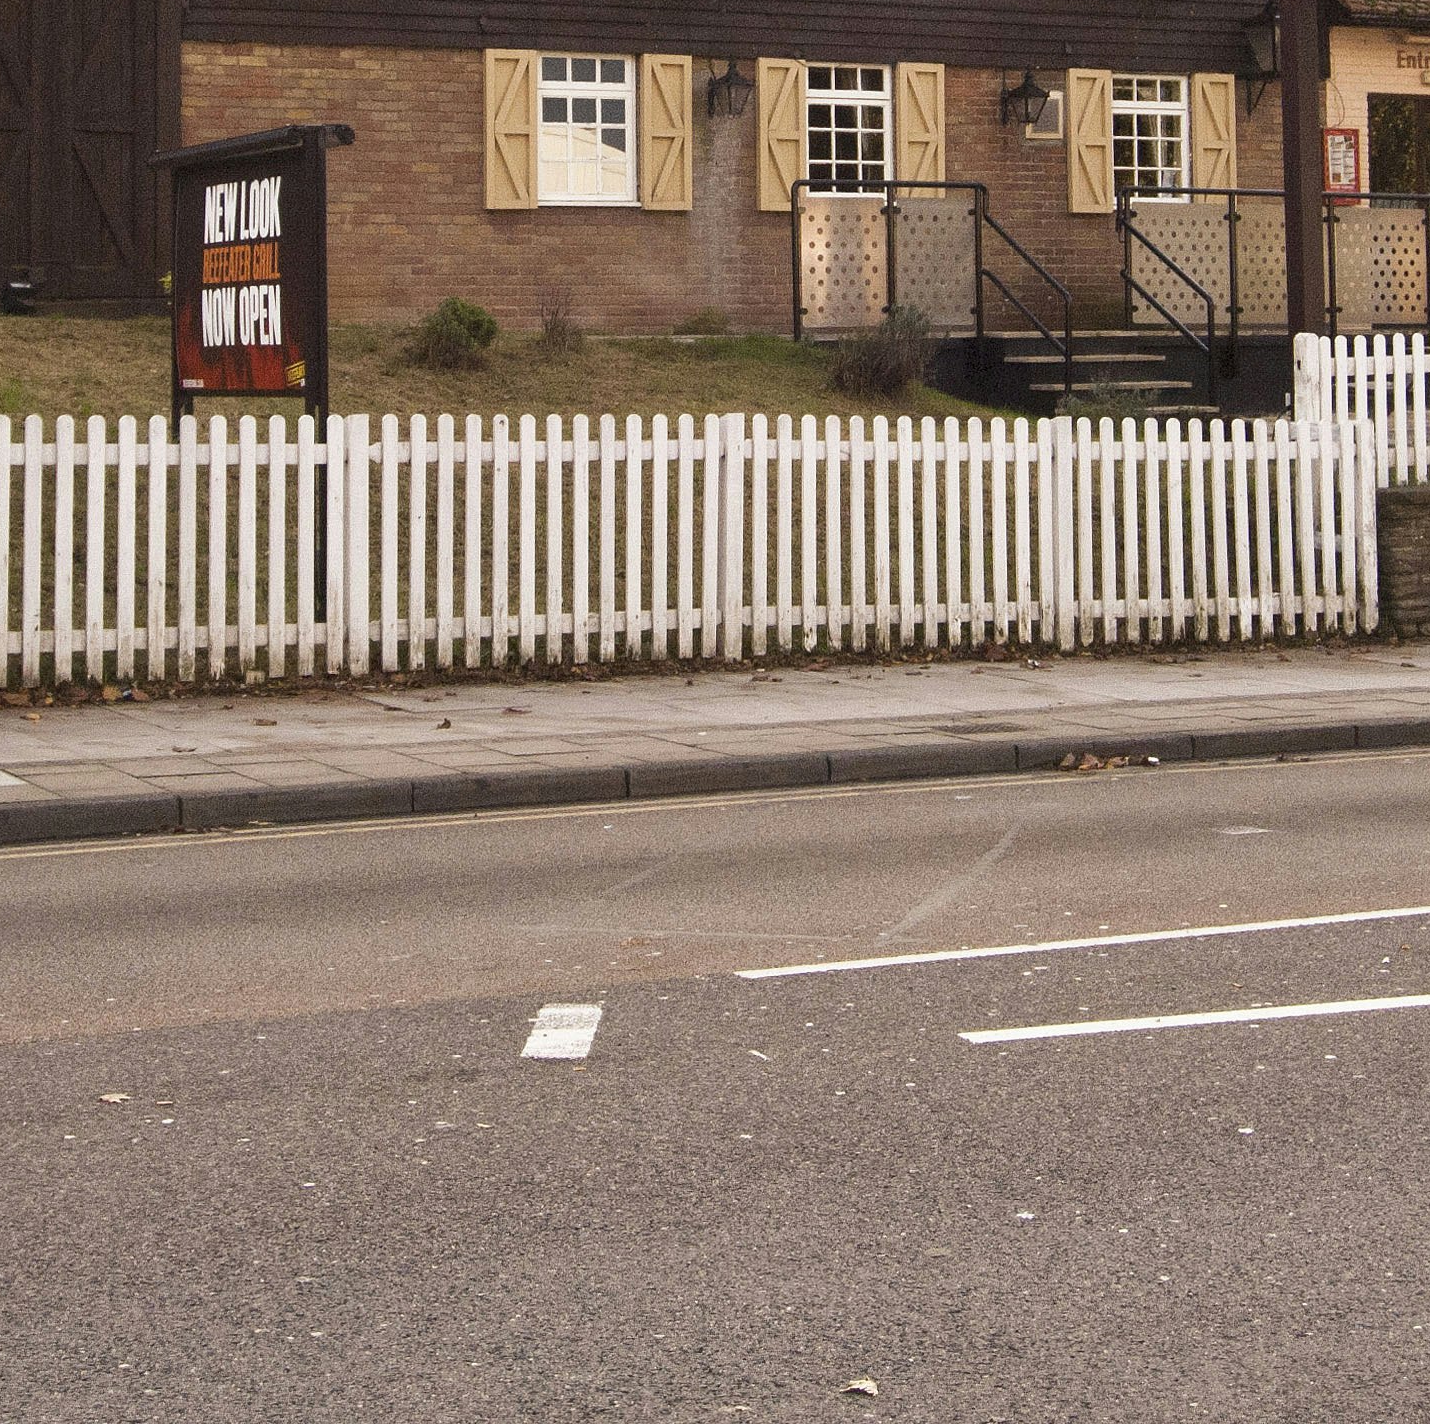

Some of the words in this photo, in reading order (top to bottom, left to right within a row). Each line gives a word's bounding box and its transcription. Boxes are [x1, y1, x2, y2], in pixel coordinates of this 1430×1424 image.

[204, 181, 238, 244] NEW
[240, 176, 281, 240] LOOK
[252, 242, 281, 280] GRILL
[202, 286, 236, 347] NOW
[239, 284, 281, 346] OPEN
